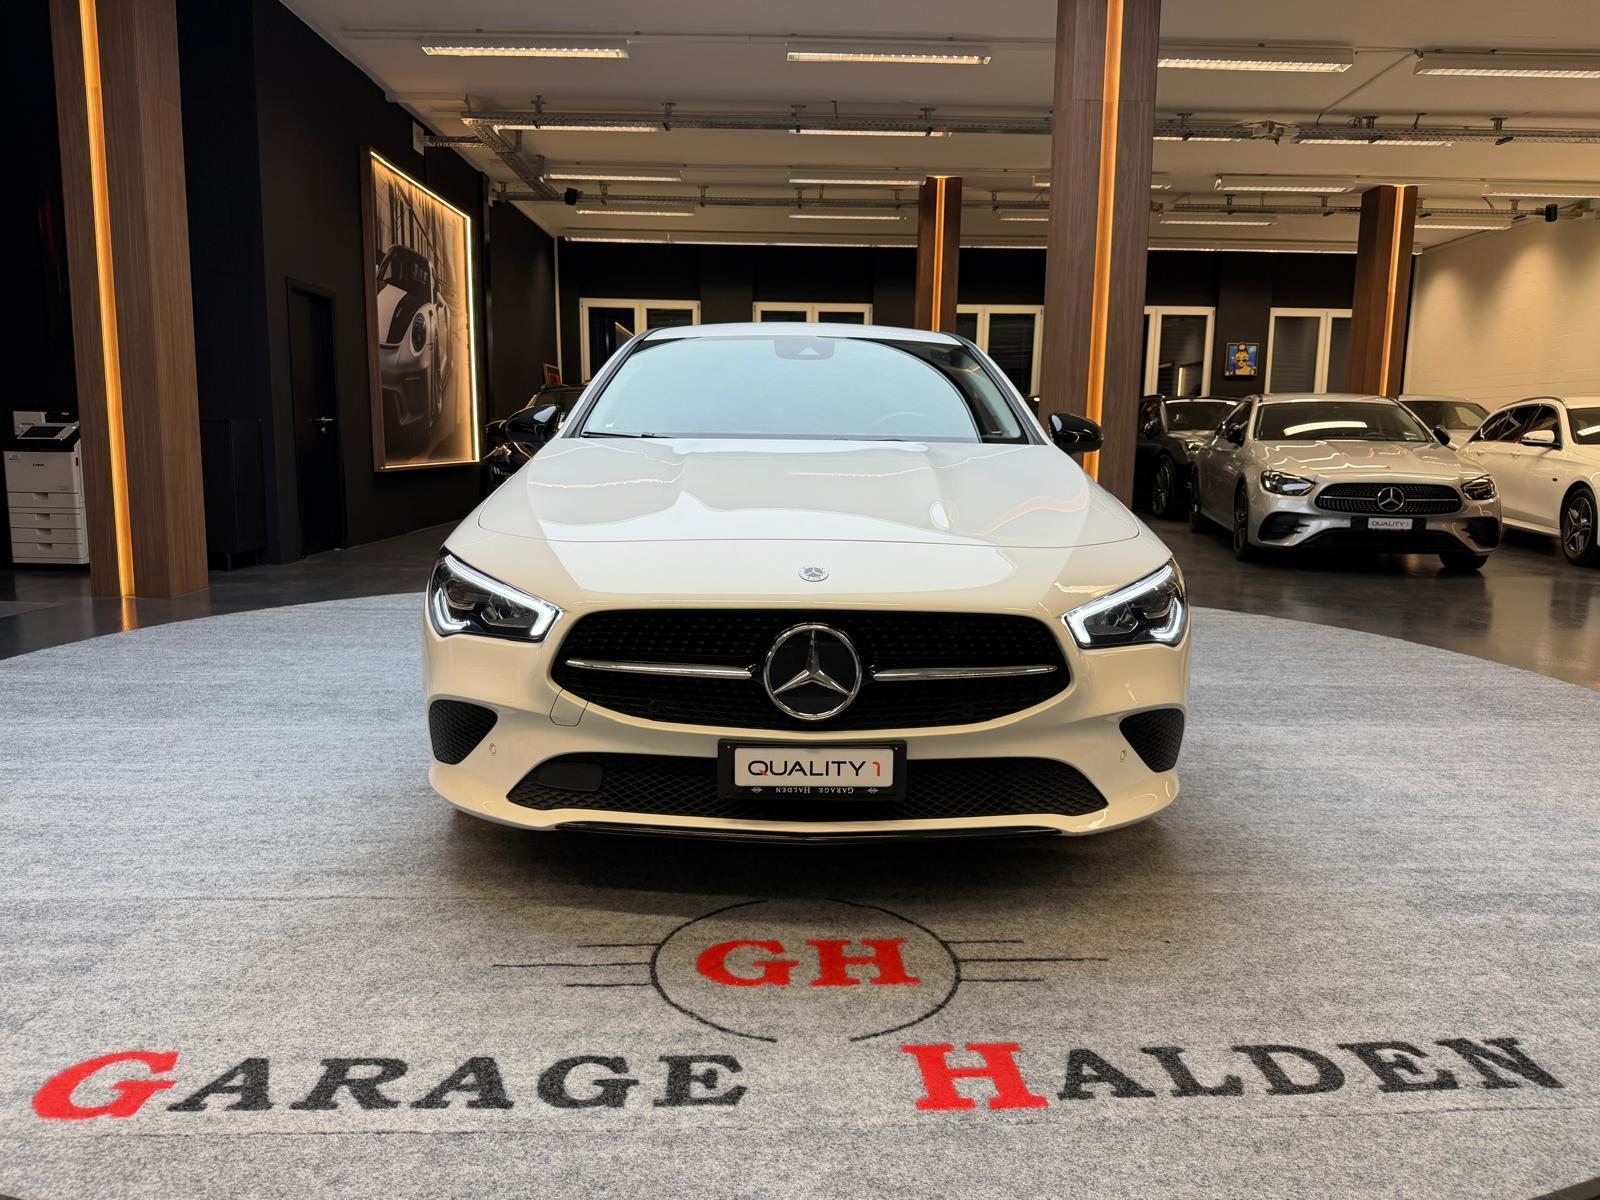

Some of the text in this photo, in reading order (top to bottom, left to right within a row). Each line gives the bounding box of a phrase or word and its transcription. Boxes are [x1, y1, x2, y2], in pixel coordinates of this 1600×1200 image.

[748, 760, 881, 777] QUALITY 1
[775, 786, 854, 795] GARAGE HALDEN
[697, 938, 921, 987] GH
[32, 1037, 1564, 1119] GARAGE HALDEN
